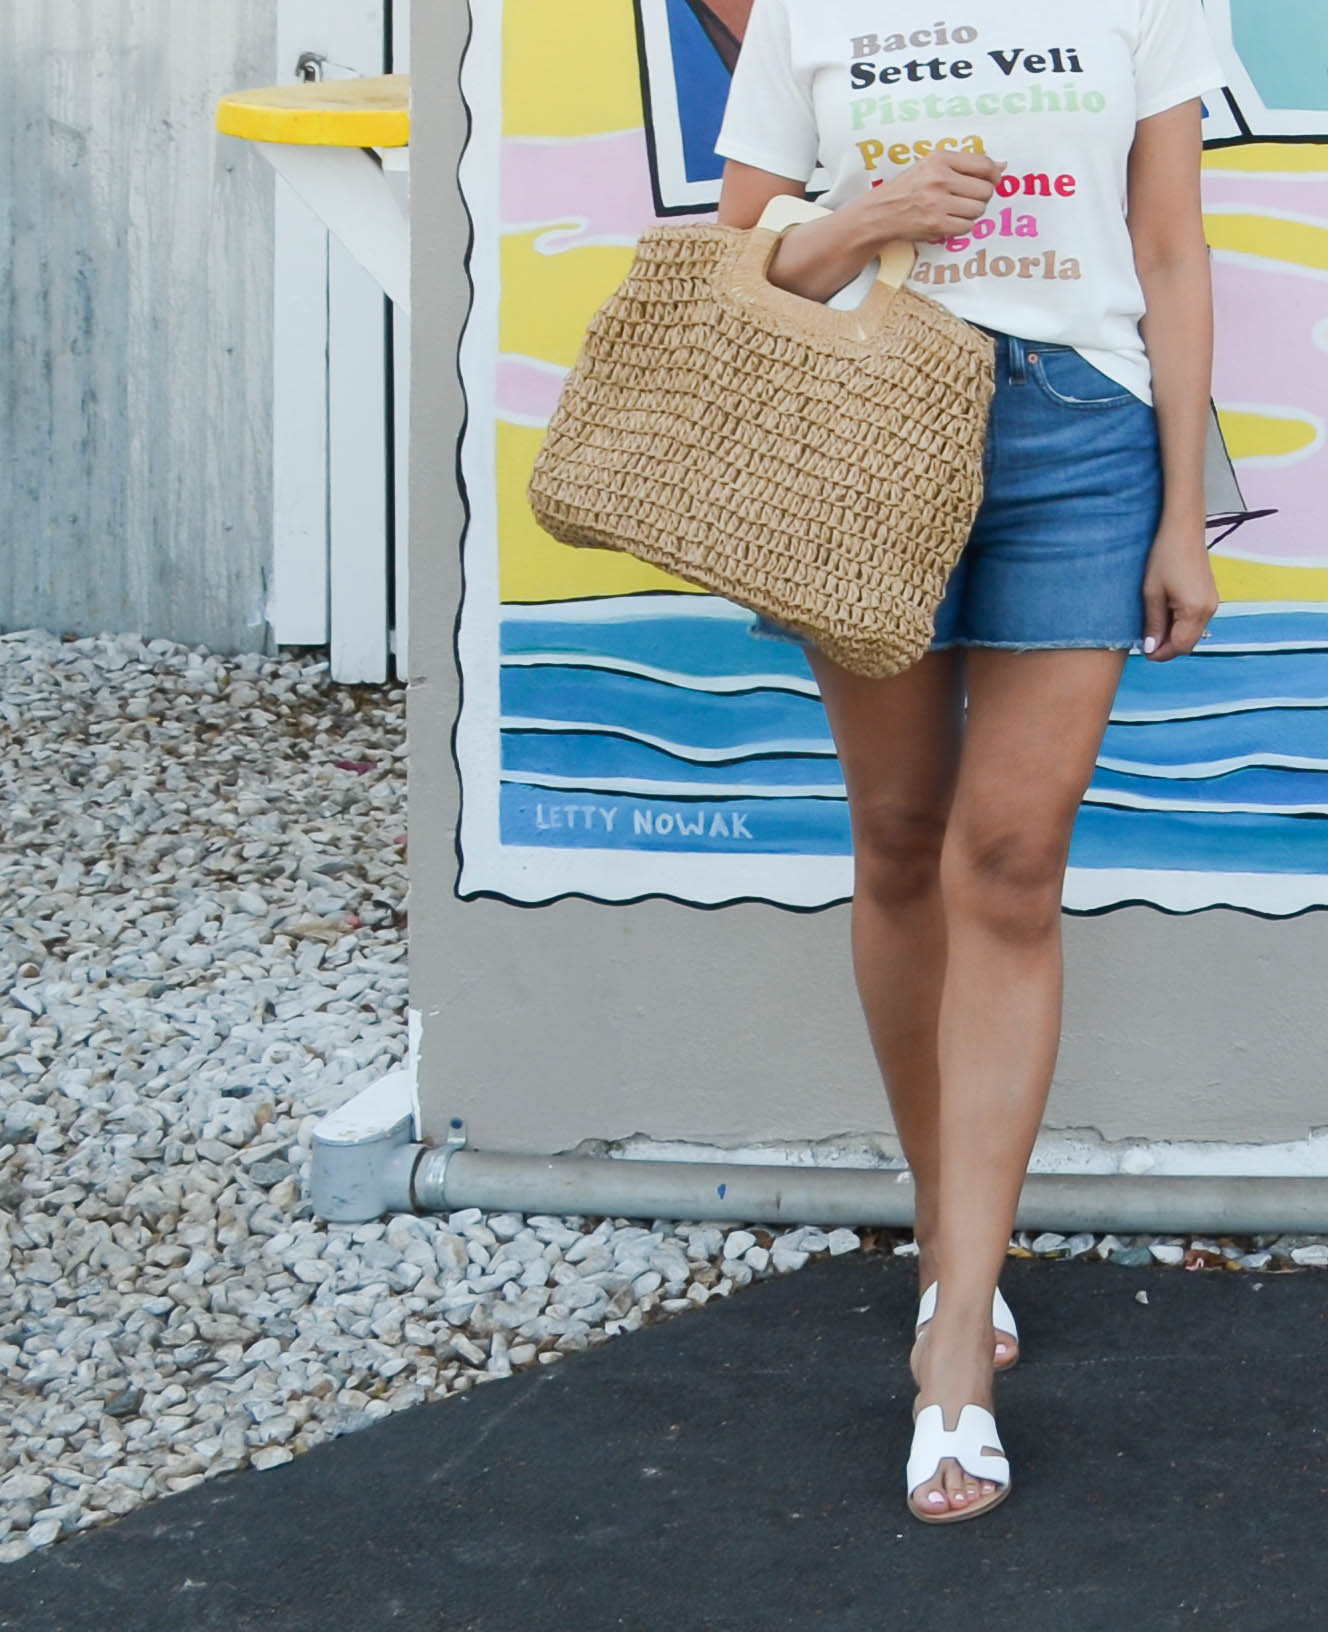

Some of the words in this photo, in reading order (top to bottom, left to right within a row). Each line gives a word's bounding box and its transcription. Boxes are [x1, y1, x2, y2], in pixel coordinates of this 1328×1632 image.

[850, 21, 979, 59] Bacio
[850, 57, 973, 90] Sette
[987, 48, 1084, 76] Veli
[850, 83, 1106, 130] Pistacchio
[909, 248, 1082, 285] andorla
[535, 802, 618, 832] LETTY
[633, 808, 753, 840] NOWAK
